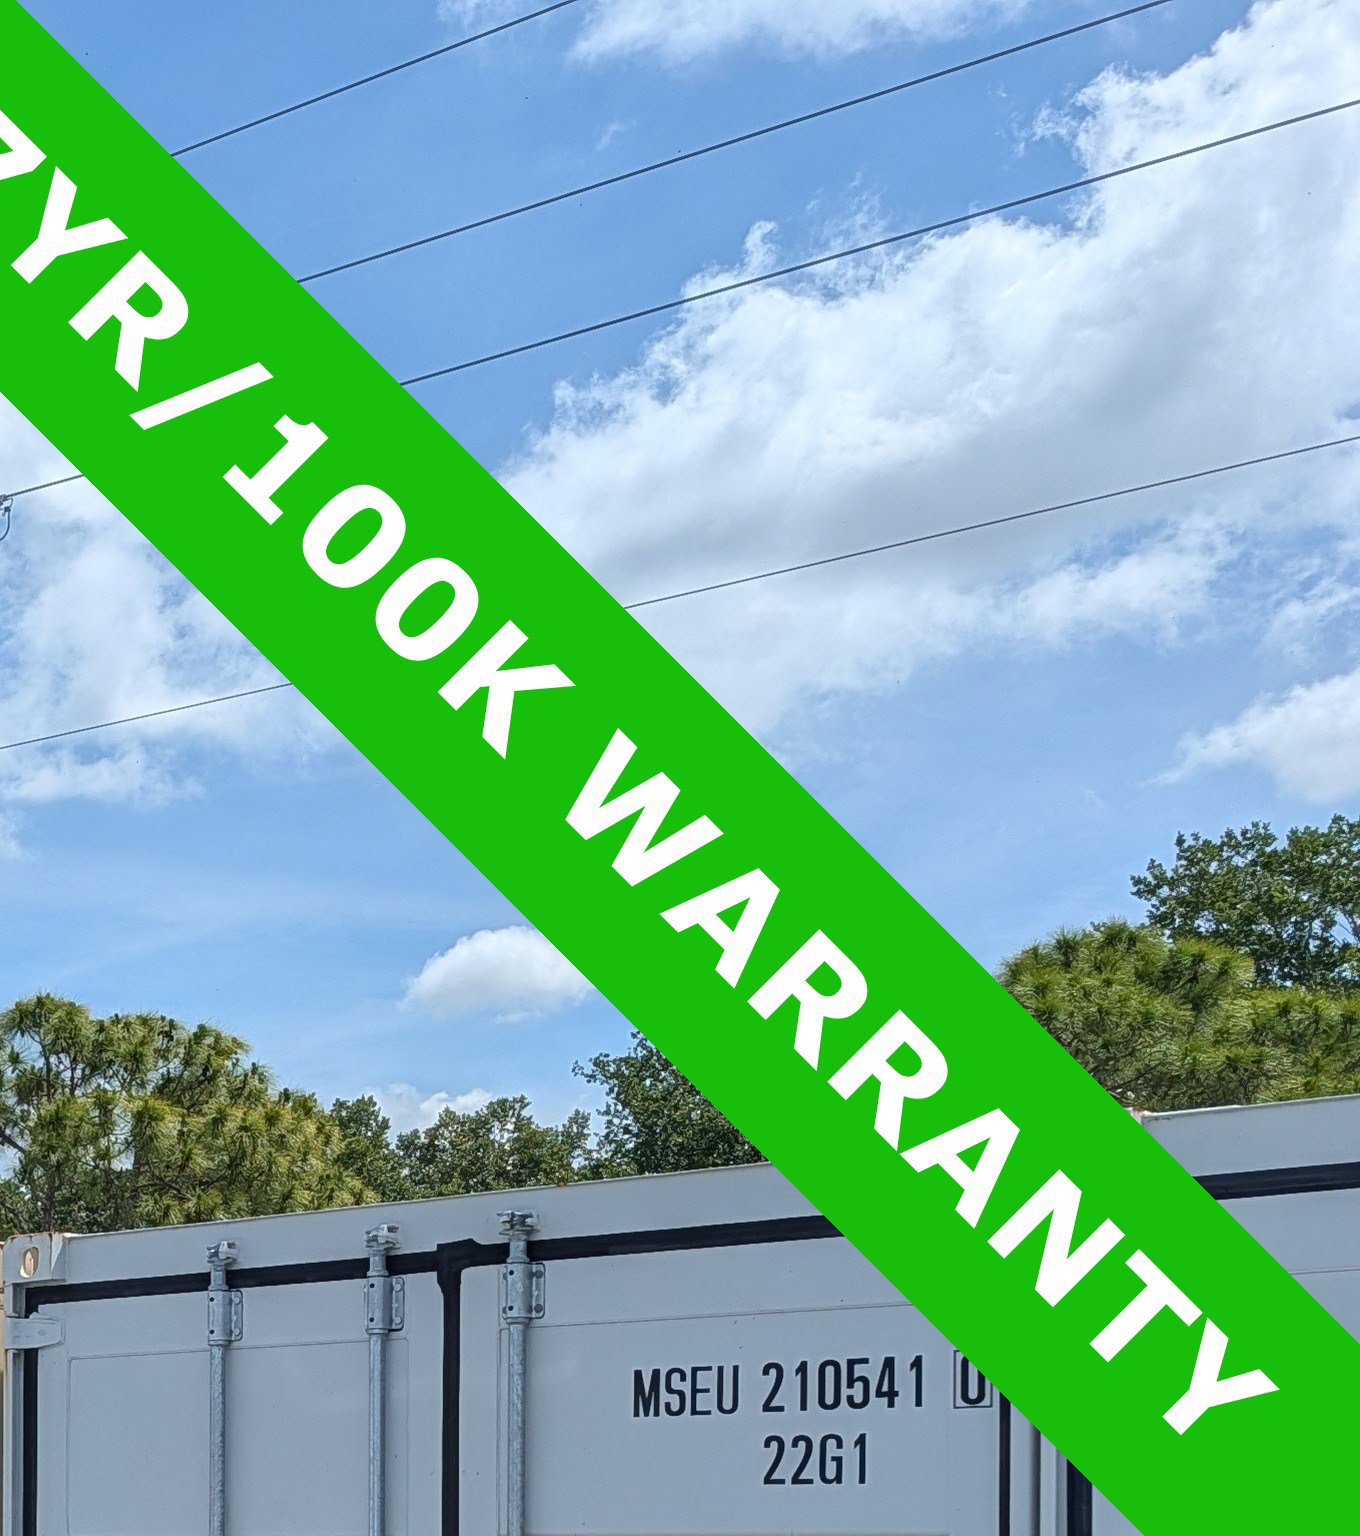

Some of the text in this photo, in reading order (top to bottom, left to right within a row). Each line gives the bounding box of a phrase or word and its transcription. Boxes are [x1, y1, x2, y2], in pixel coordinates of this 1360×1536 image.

[633, 1365, 739, 1417] MSEU
[762, 1355, 923, 1412] 210541
[763, 1433, 867, 1485] 22G1
